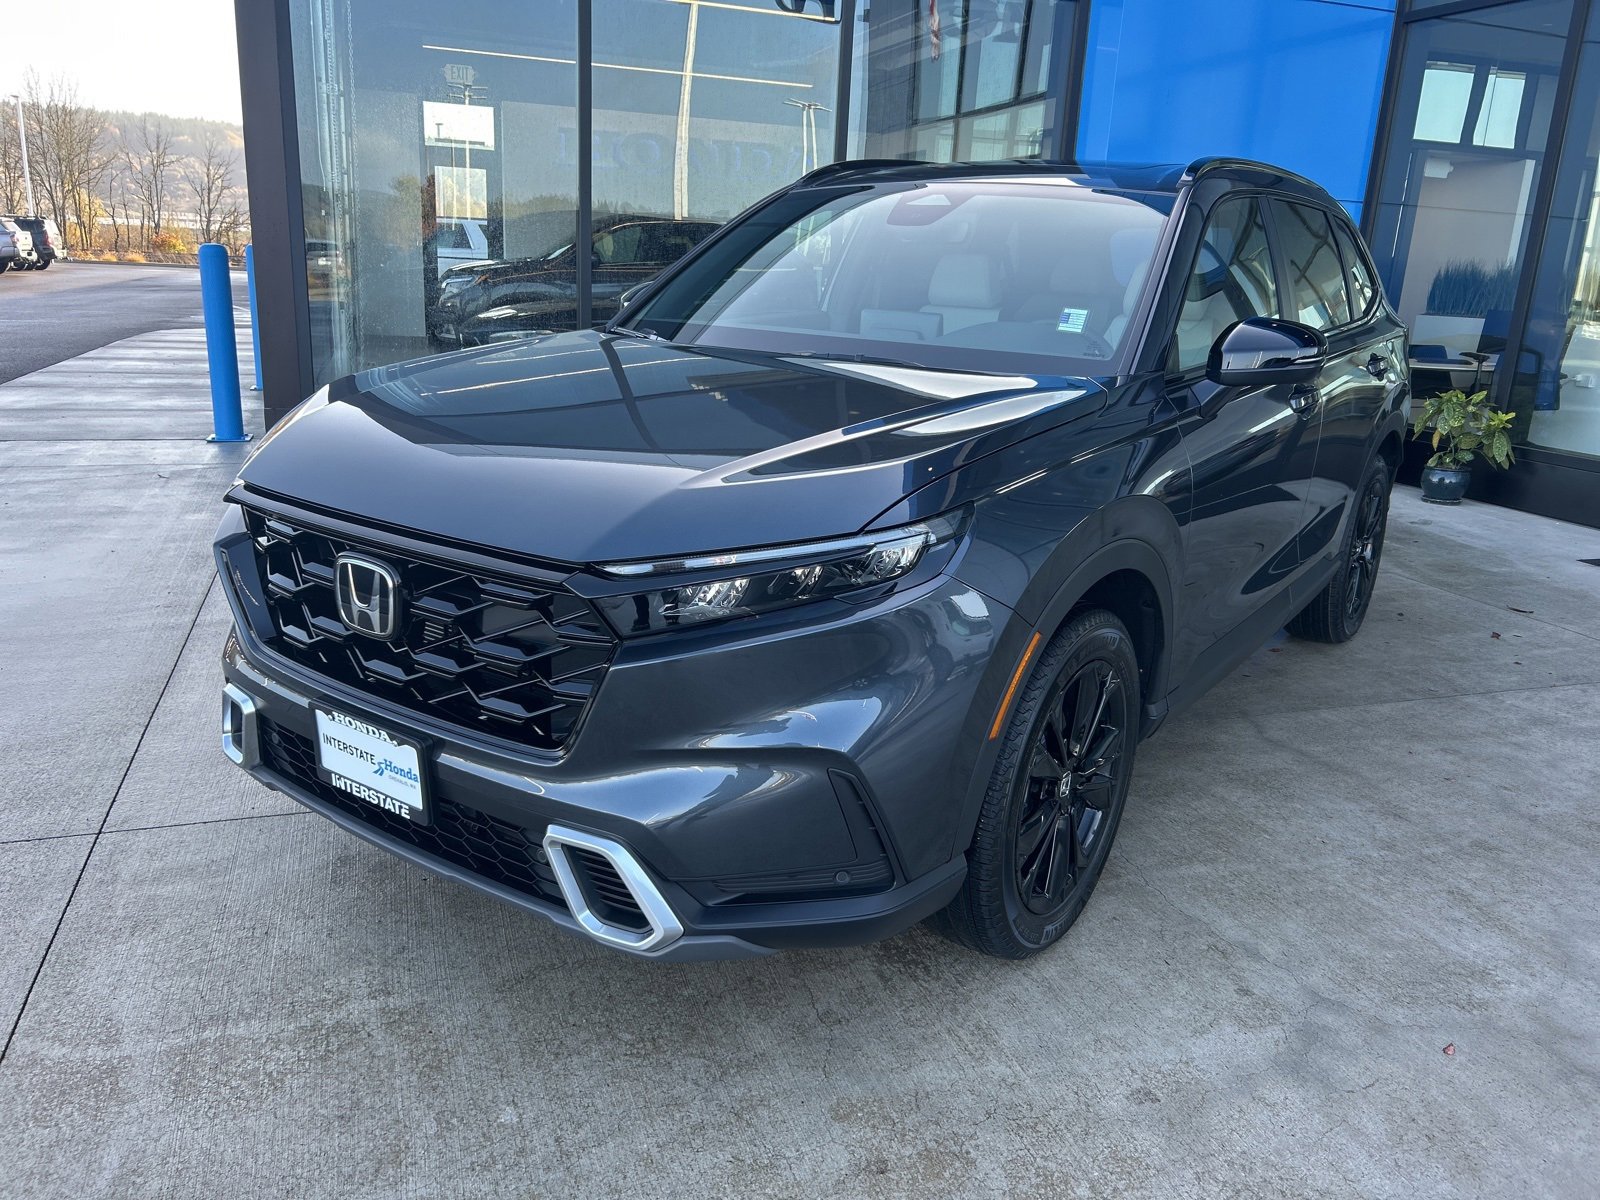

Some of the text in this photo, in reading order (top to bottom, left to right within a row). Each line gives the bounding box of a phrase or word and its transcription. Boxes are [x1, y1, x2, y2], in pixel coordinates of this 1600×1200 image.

[450, 65, 469, 81] EXIT
[332, 711, 392, 743] HONDA
[323, 733, 376, 765] INTERSTATE
[383, 758, 419, 783] Honda
[332, 773, 410, 819] INTERSTATE
